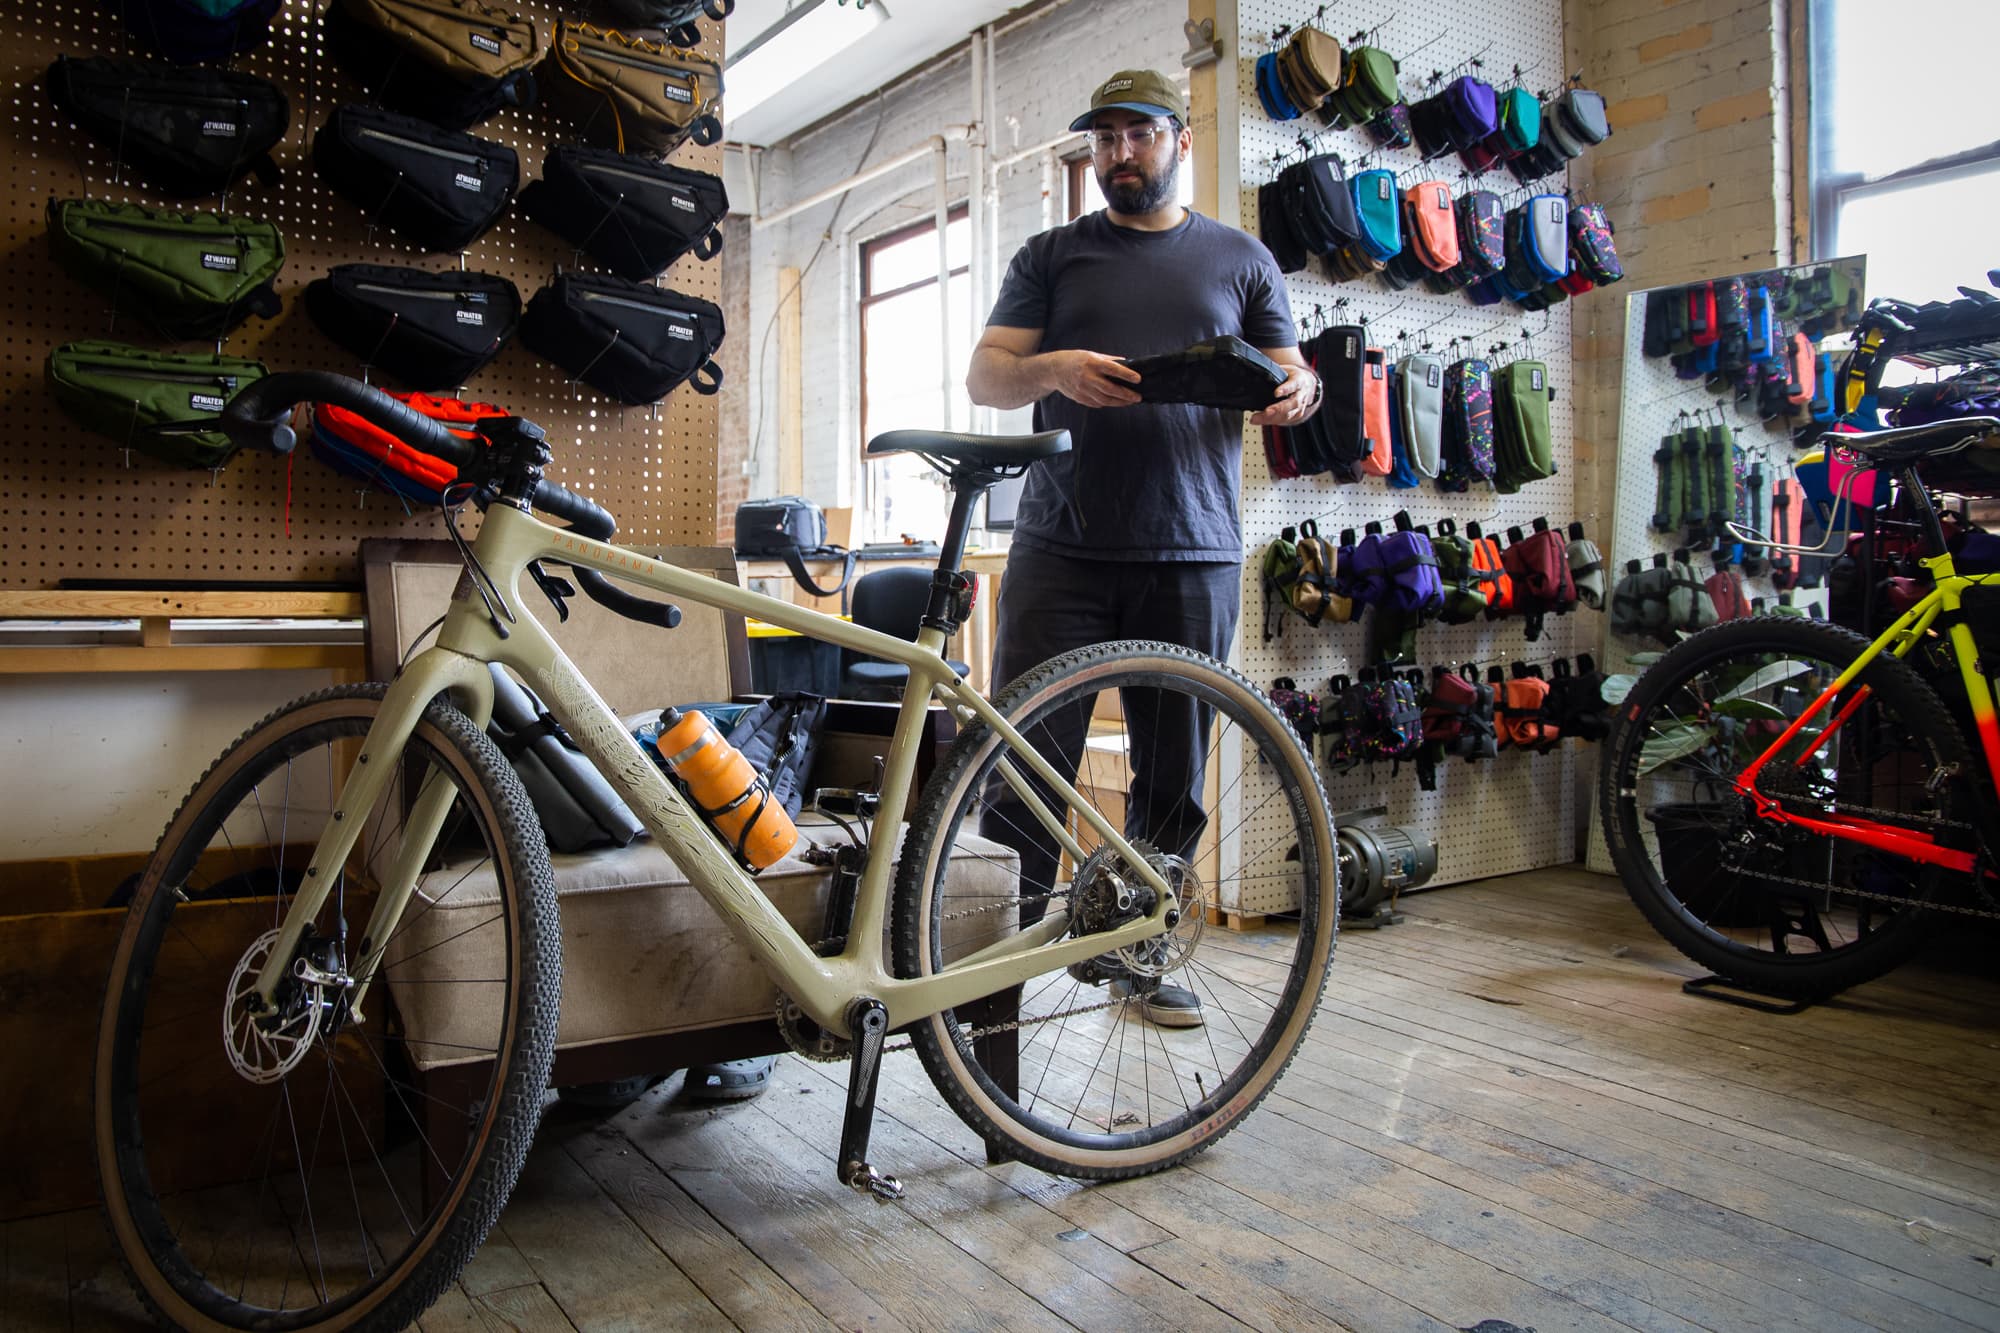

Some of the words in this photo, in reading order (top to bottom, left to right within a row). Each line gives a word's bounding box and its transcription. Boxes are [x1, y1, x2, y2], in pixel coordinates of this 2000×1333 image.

[472, 34, 499, 49] ATWATER
[667, 86, 691, 98] ATWATER
[203, 121, 236, 131] ATWATER
[456, 173, 482, 187] ATWATER
[672, 196, 695, 209] ATWATER
[204, 254, 236, 265] ATWATER
[457, 310, 482, 321] ATWATER
[669, 324, 694, 336] ATWATER
[192, 395, 224, 406] ATWATER
[553, 533, 654, 576] PANORAMA
